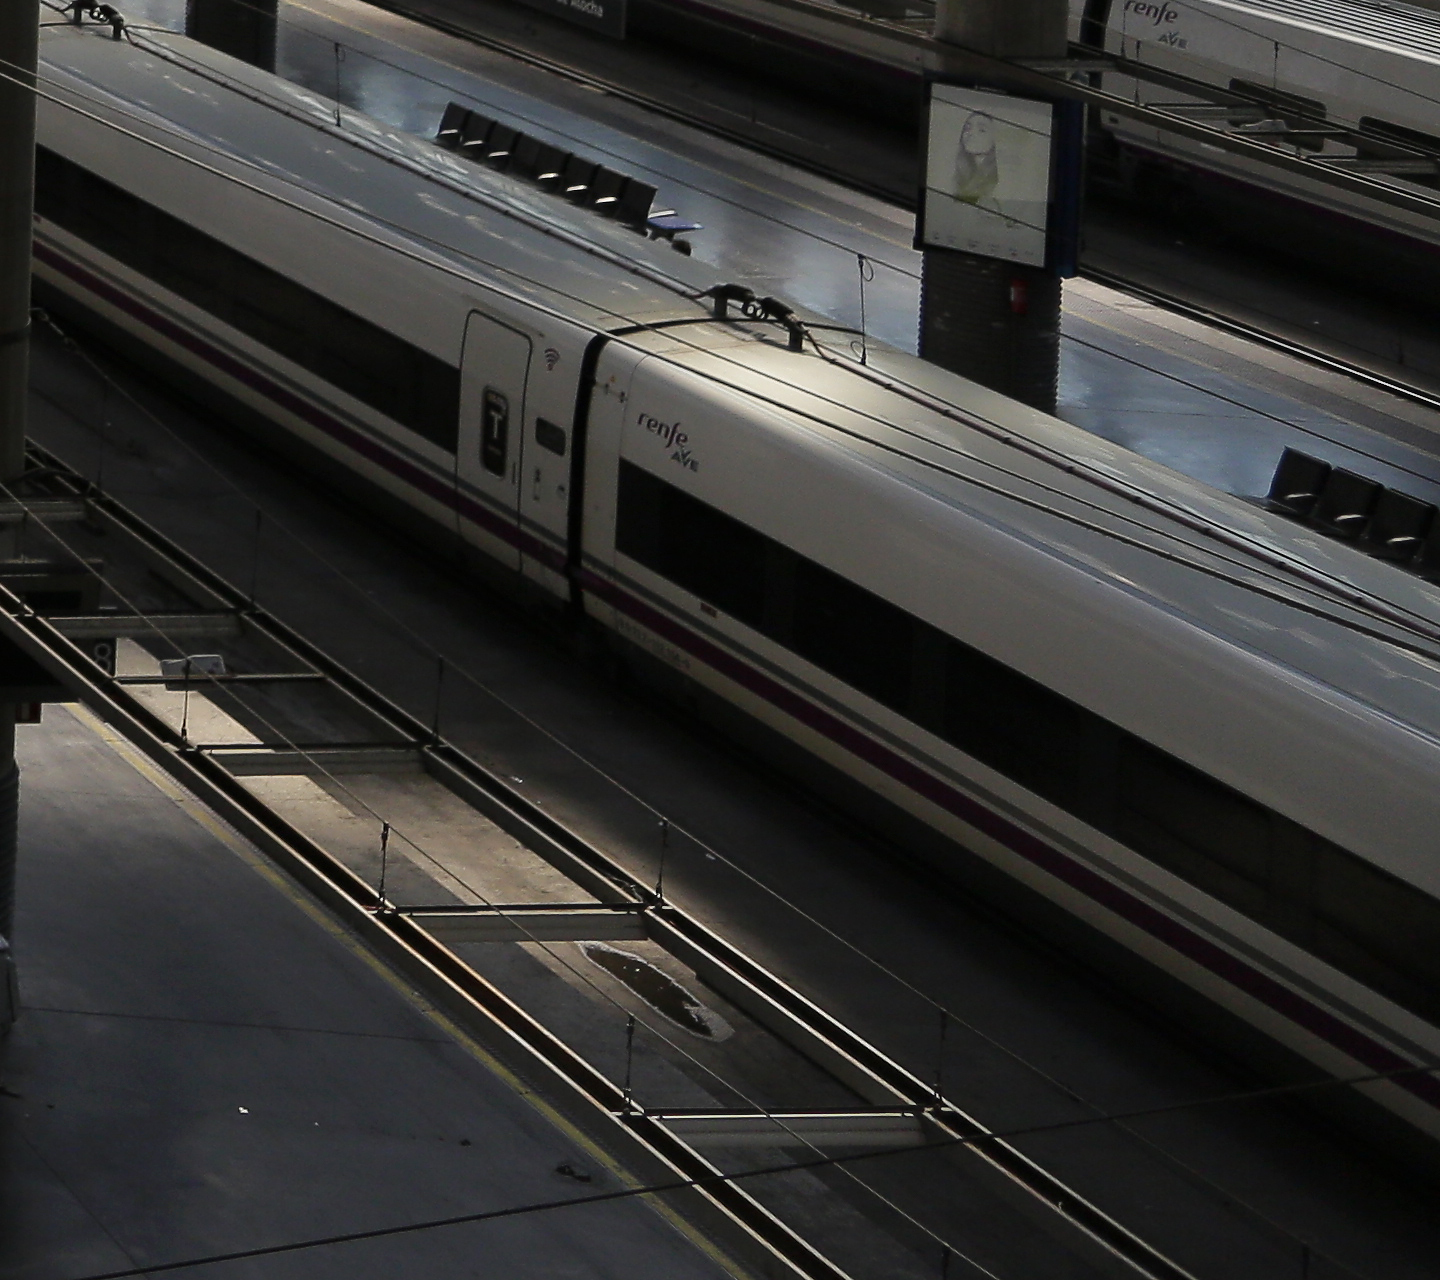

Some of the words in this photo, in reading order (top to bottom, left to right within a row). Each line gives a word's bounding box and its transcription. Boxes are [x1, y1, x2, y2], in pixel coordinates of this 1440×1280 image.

[1124, 0, 1178, 27] renfe
[1158, 31, 1188, 49] AVE
[637, 412, 688, 449] renfe
[671, 447, 700, 473] AVE
[93, 642, 113, 673] 8
